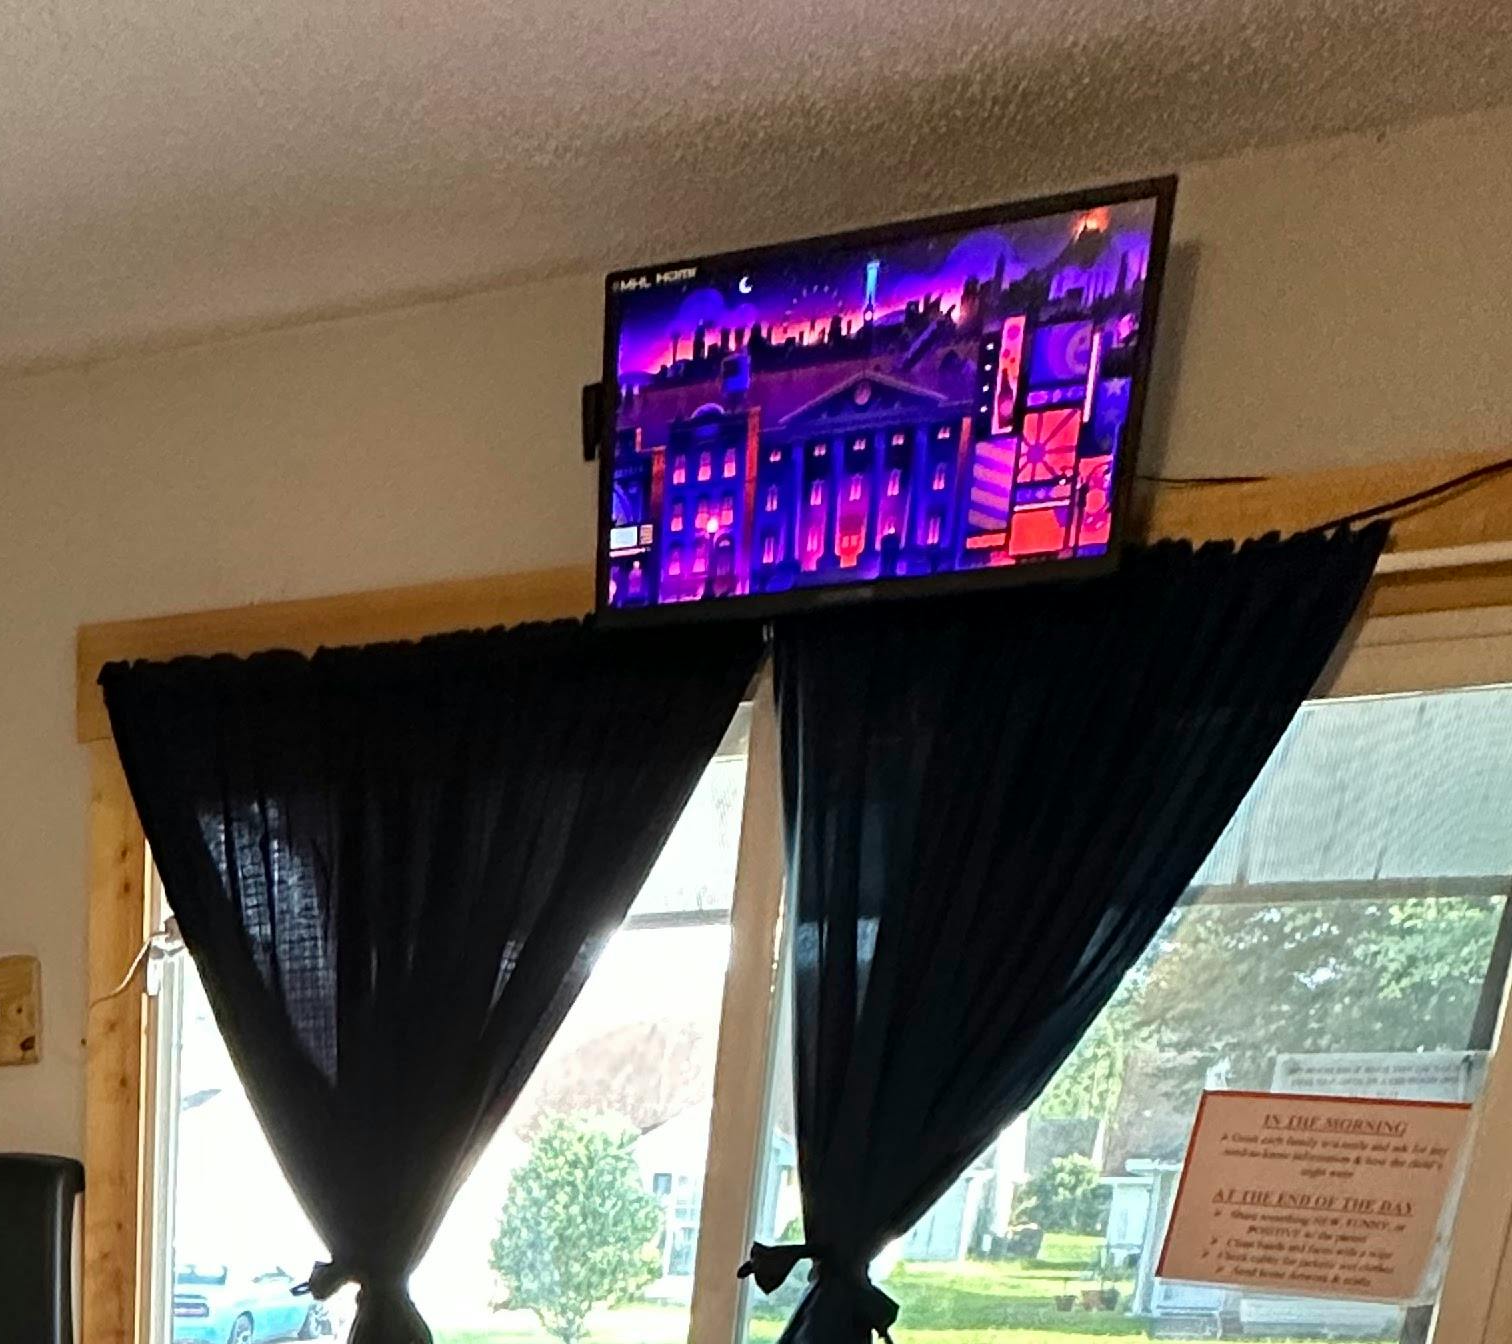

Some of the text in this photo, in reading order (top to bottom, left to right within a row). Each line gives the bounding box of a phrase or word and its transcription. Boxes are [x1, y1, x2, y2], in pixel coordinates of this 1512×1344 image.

[1262, 1113, 1408, 1135] IN THE MORNING
[1212, 1187, 1235, 1201] AT
[1241, 1189, 1272, 1204] THE
[1276, 1192, 1310, 1207] END
[1341, 1197, 1376, 1212] THE
[1379, 1200, 1416, 1216] DAY
